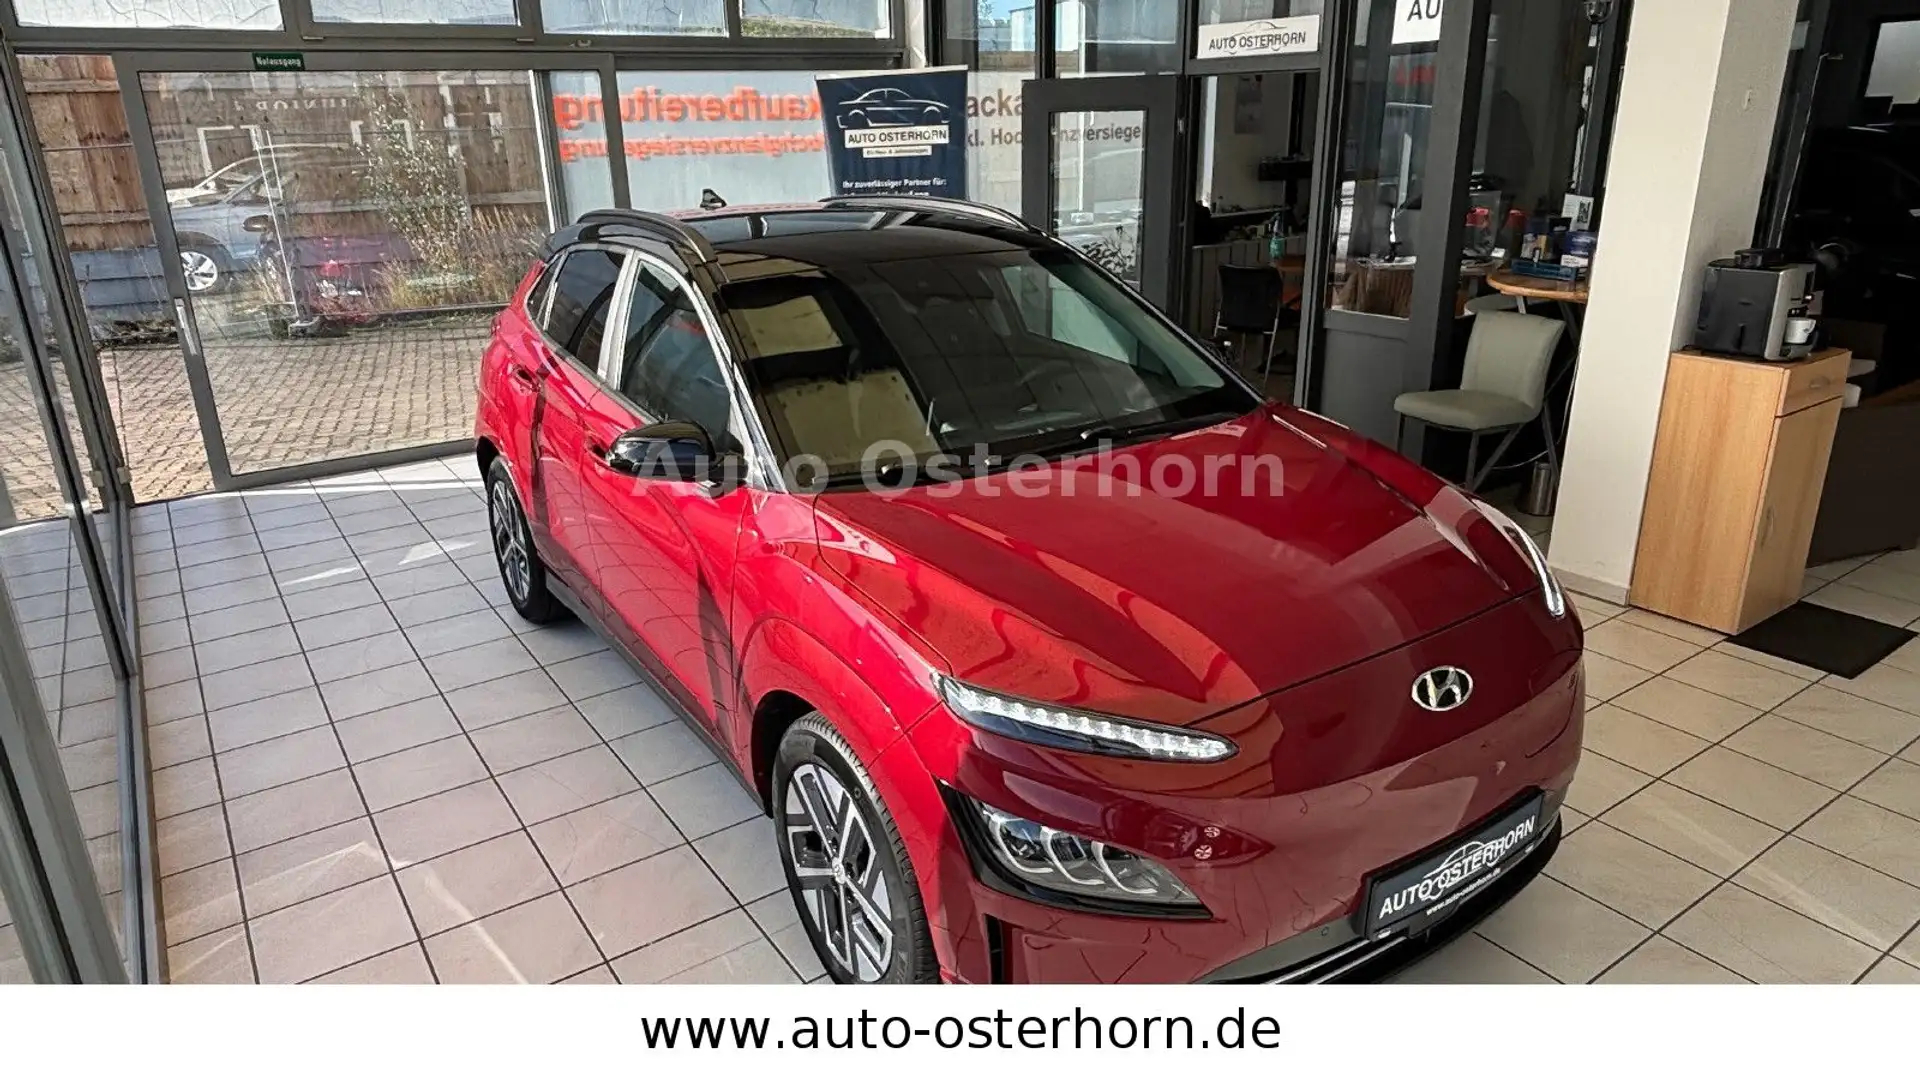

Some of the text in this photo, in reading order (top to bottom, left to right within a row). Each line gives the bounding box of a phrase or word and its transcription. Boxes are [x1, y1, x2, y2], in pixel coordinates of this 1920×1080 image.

[1407, 0, 1441, 22] AU
[1209, 31, 1306, 51] AUTO OSTERHORN
[848, 130, 947, 145] AUTO OSTERHORN
[904, 178, 931, 187] Partner
[1379, 815, 1535, 919] AUTO OSTERHORN
